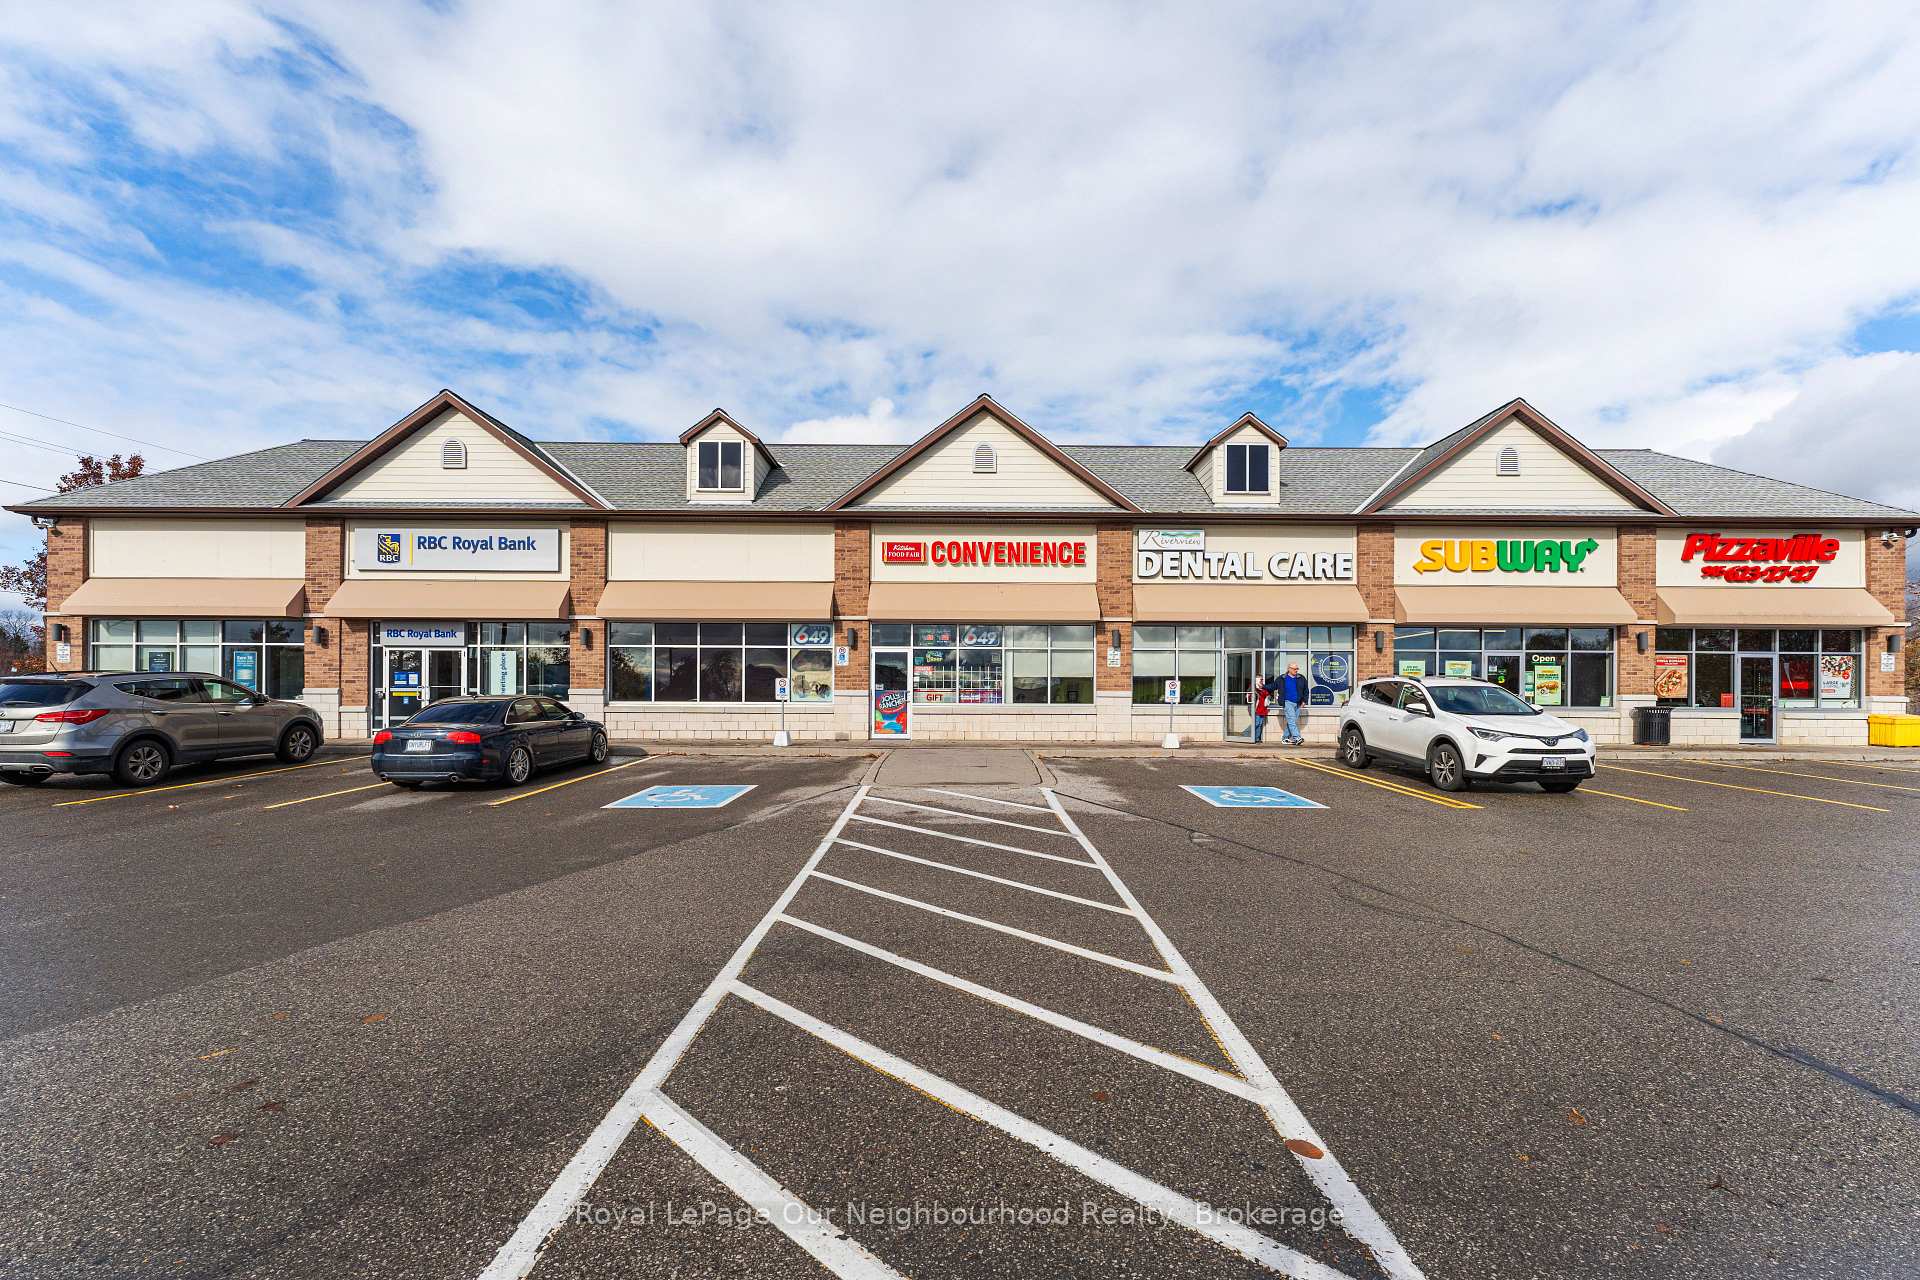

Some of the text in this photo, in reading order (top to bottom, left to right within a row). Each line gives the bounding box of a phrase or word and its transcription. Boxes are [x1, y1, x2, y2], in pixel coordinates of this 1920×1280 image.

[417, 536, 537, 554] RBC Royal Bank
[1143, 530, 1201, 548] Riverview
[1681, 533, 1840, 562] Pizzaville
[379, 554, 399, 562] RBC
[931, 540, 1087, 566] CONVENIENCE
[1412, 538, 1600, 575] SUBWAY
[1137, 551, 1353, 580] DENTAL CARE
[386, 629, 457, 640] RBC Royal Bank
[1532, 654, 1556, 664] Open
[926, 693, 944, 702] GIFT
